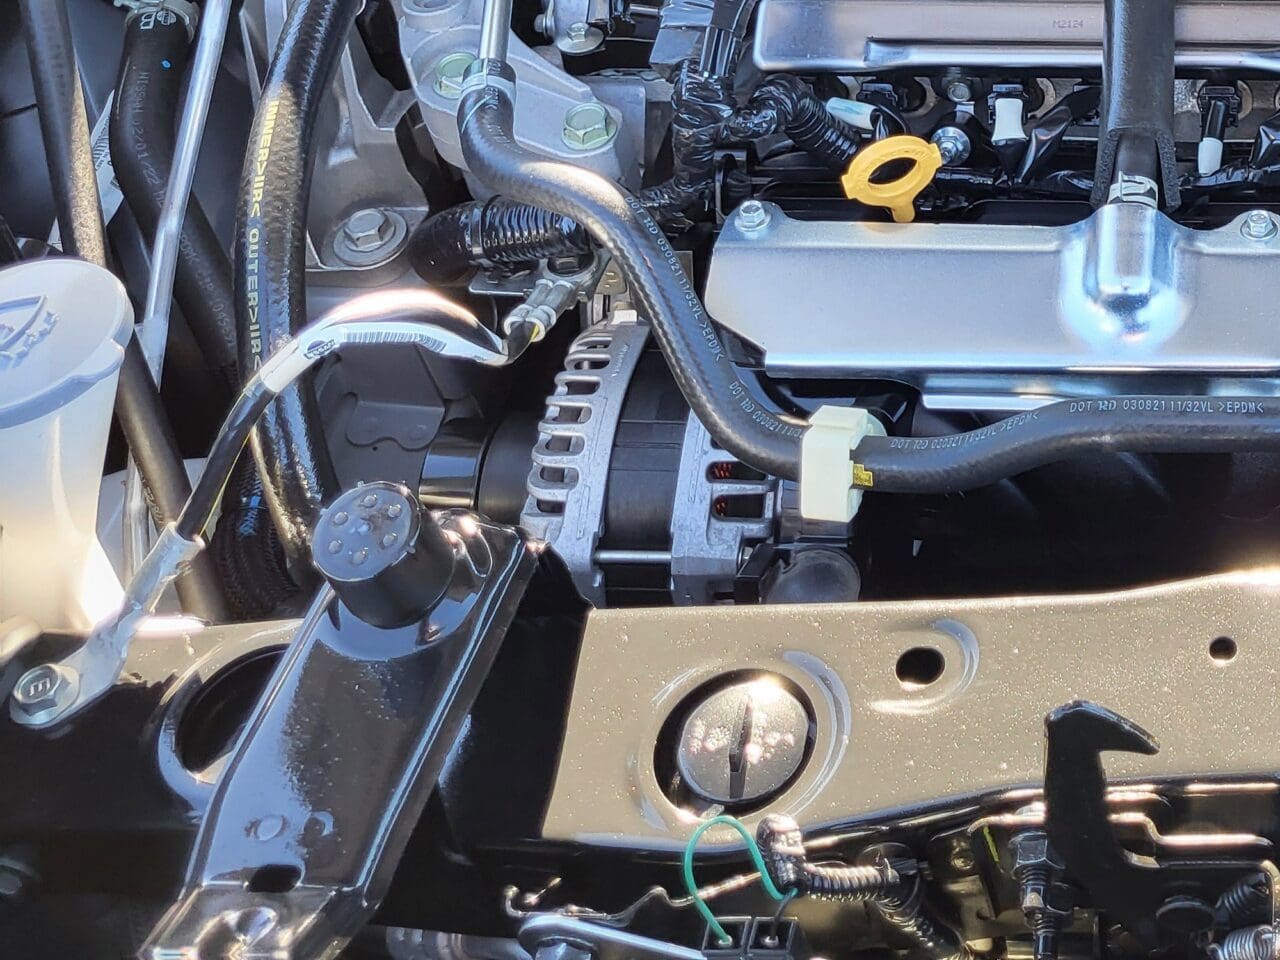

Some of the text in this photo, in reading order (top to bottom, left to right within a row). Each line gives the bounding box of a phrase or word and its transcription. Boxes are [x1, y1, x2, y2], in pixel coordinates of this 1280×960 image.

[625, 197, 644, 214] DOT
[1069, 400, 1093, 413] DOT
[1123, 399, 1165, 411] 030821
[1218, 401, 1264, 413] >EPDM<
